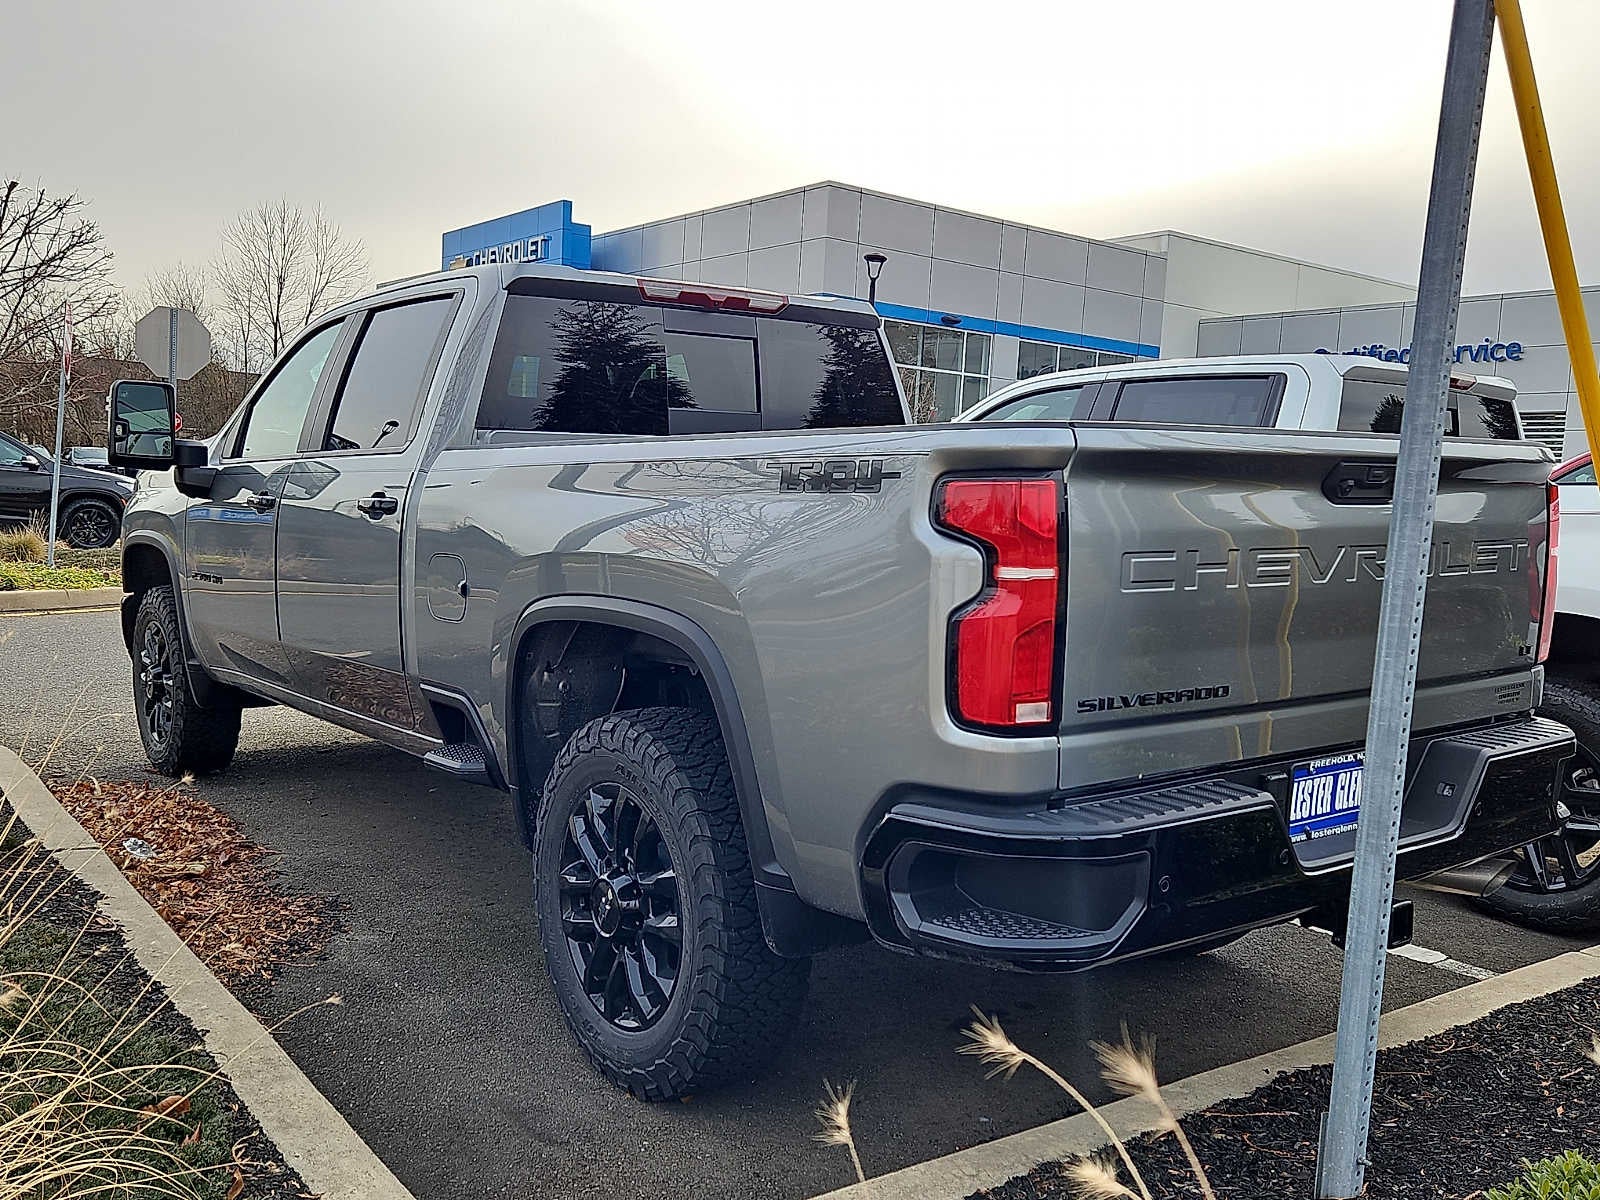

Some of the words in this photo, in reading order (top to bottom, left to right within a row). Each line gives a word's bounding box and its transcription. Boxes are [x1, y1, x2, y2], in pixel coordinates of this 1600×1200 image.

[472, 234, 547, 266] CHEVROLET
[1454, 337, 1523, 363] rvice
[1120, 538, 1528, 592] CHEVRLET
[1076, 685, 1231, 713] SILVERADO
[1290, 776, 1334, 821] LESTER
[1335, 770, 1362, 811] GLEN
